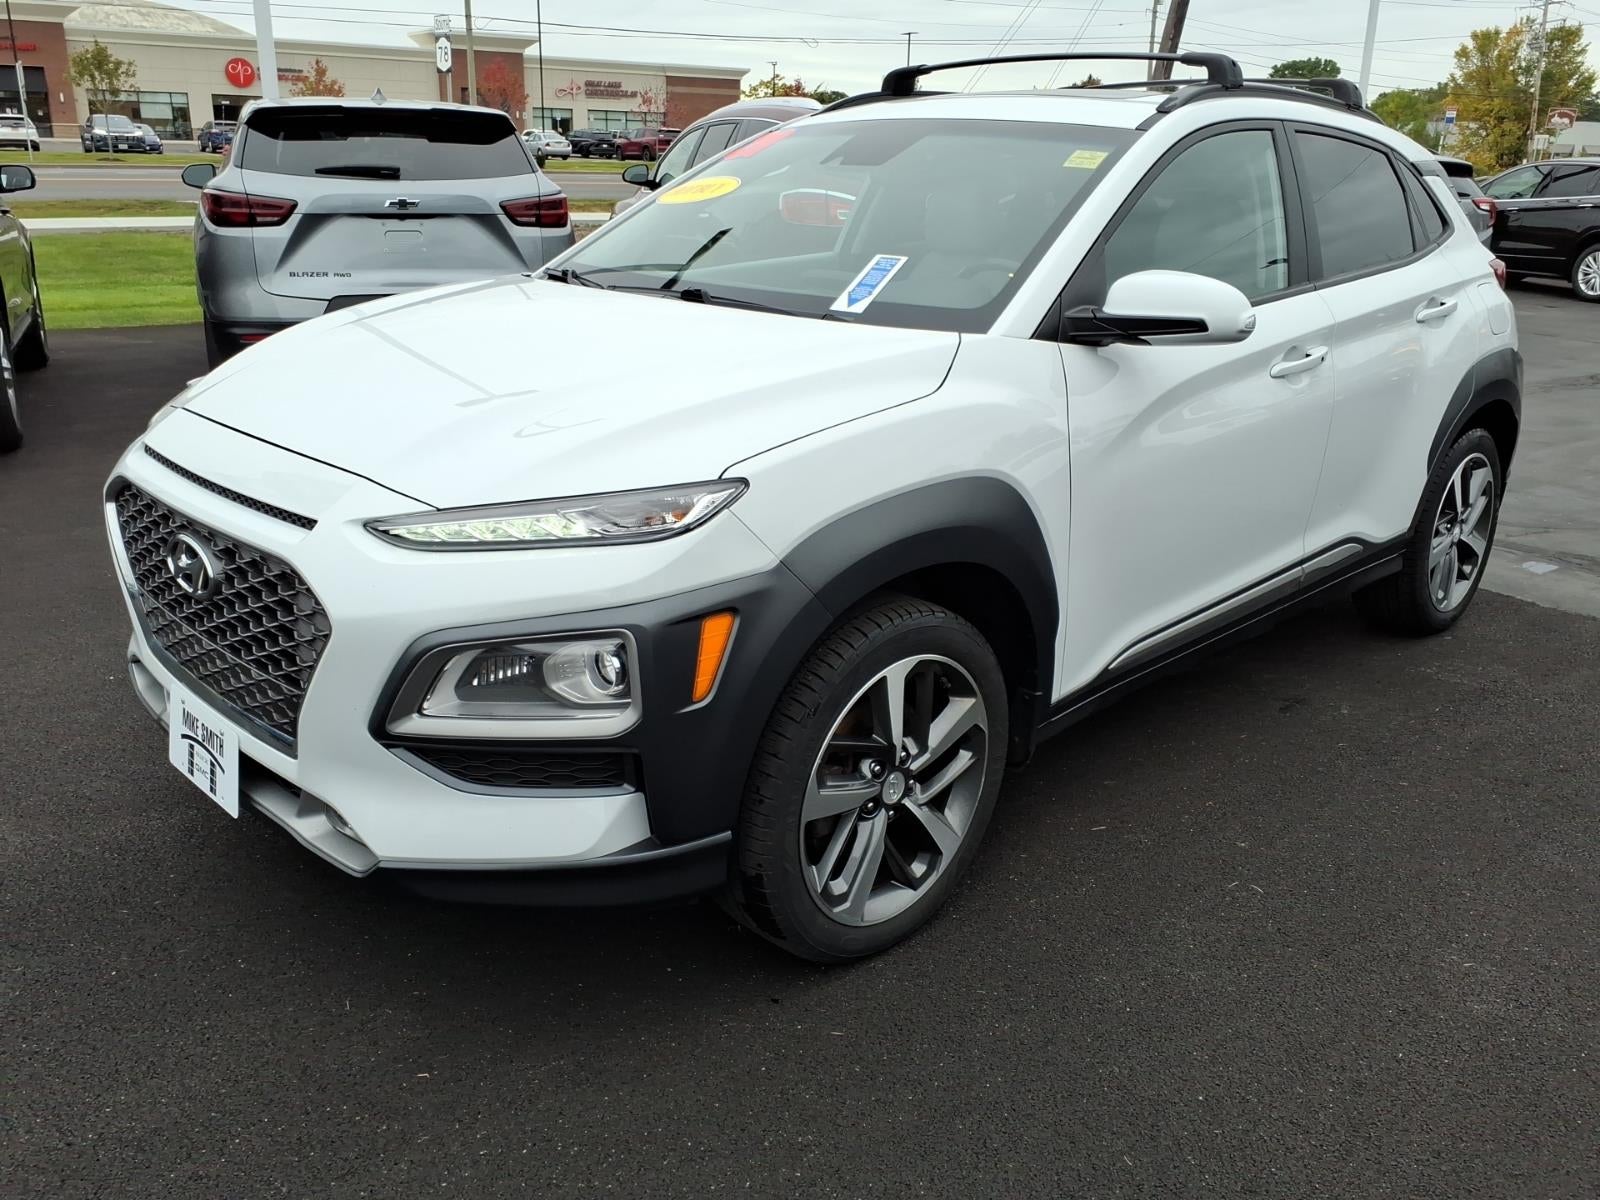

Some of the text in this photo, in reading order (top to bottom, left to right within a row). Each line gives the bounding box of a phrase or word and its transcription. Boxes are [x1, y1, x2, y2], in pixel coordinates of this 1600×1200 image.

[438, 46, 449, 63] 78
[182, 707, 224, 758] MIKE SMITH
[195, 763, 209, 780] GMC
